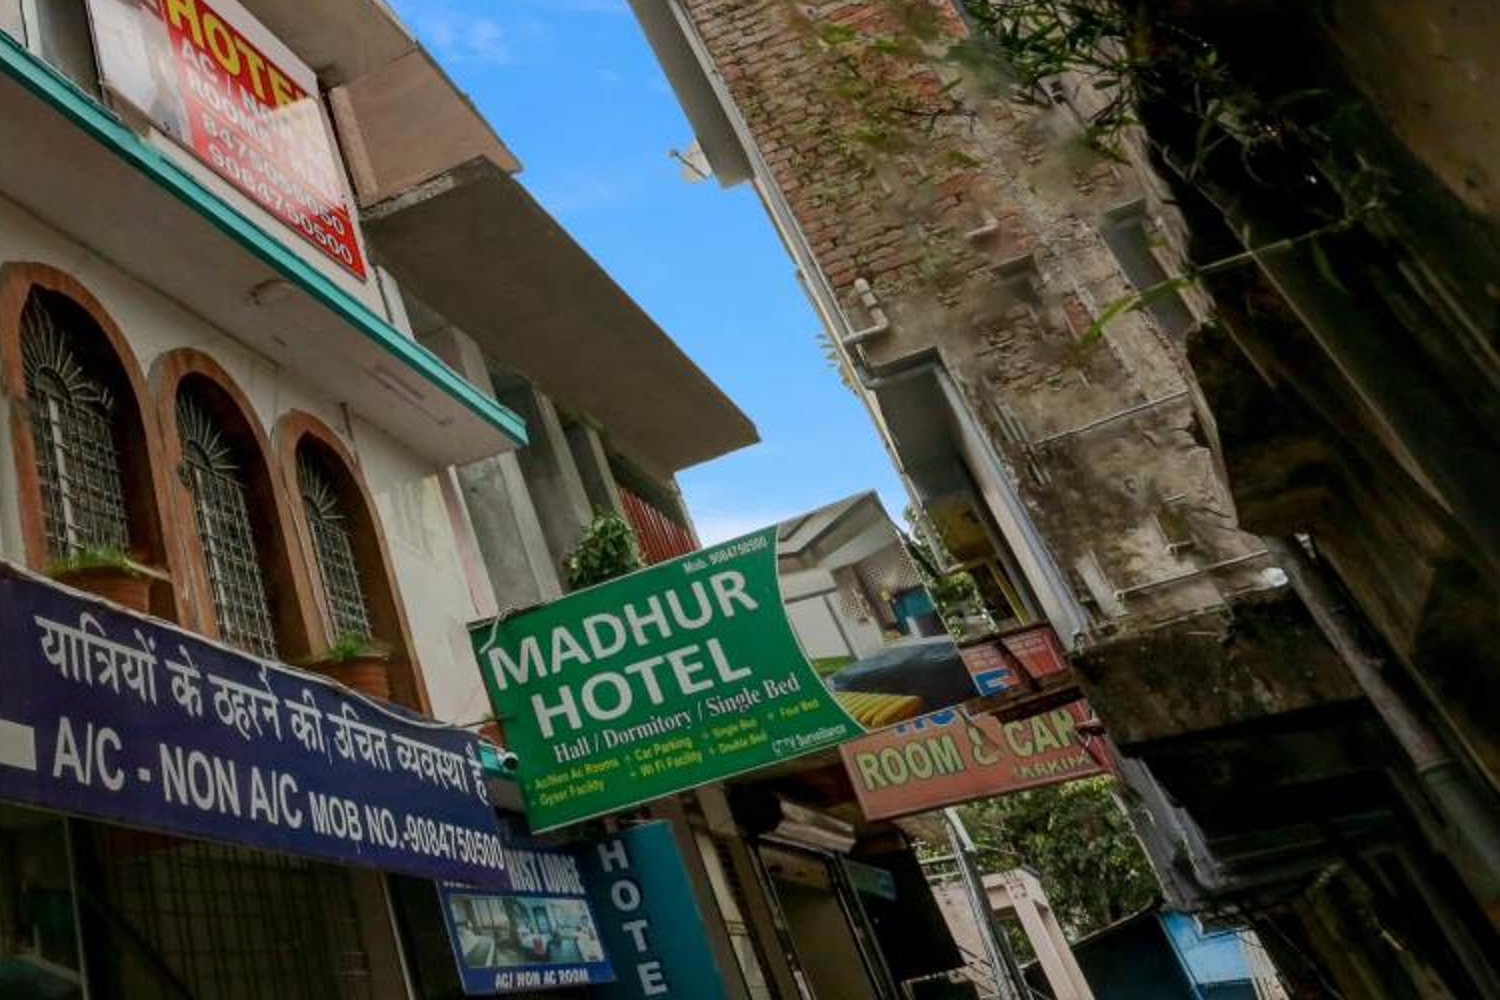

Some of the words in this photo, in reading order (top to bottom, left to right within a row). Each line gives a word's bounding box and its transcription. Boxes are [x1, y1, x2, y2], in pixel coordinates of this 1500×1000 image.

[488, 570, 759, 692] MADHUR
[34, 611, 157, 705] यात्रियों
[165, 644, 204, 717] के
[207, 666, 281, 742] ठहरने
[284, 688, 325, 753] की
[327, 702, 393, 773] उचित
[391, 733, 470, 794] व्यवस्था
[465, 741, 489, 807] है
[531, 637, 753, 739] HOTEL
[553, 736, 591, 763] Hall
[603, 709, 693, 749] Dormitory
[705, 687, 762, 717] Single
[763, 671, 801, 699] Bed
[52, 716, 125, 791] A/C
[159, 743, 241, 816] NON
[250, 766, 303, 829] A/C
[308, 791, 362, 841] MOB
[855, 734, 966, 792] ROOM
